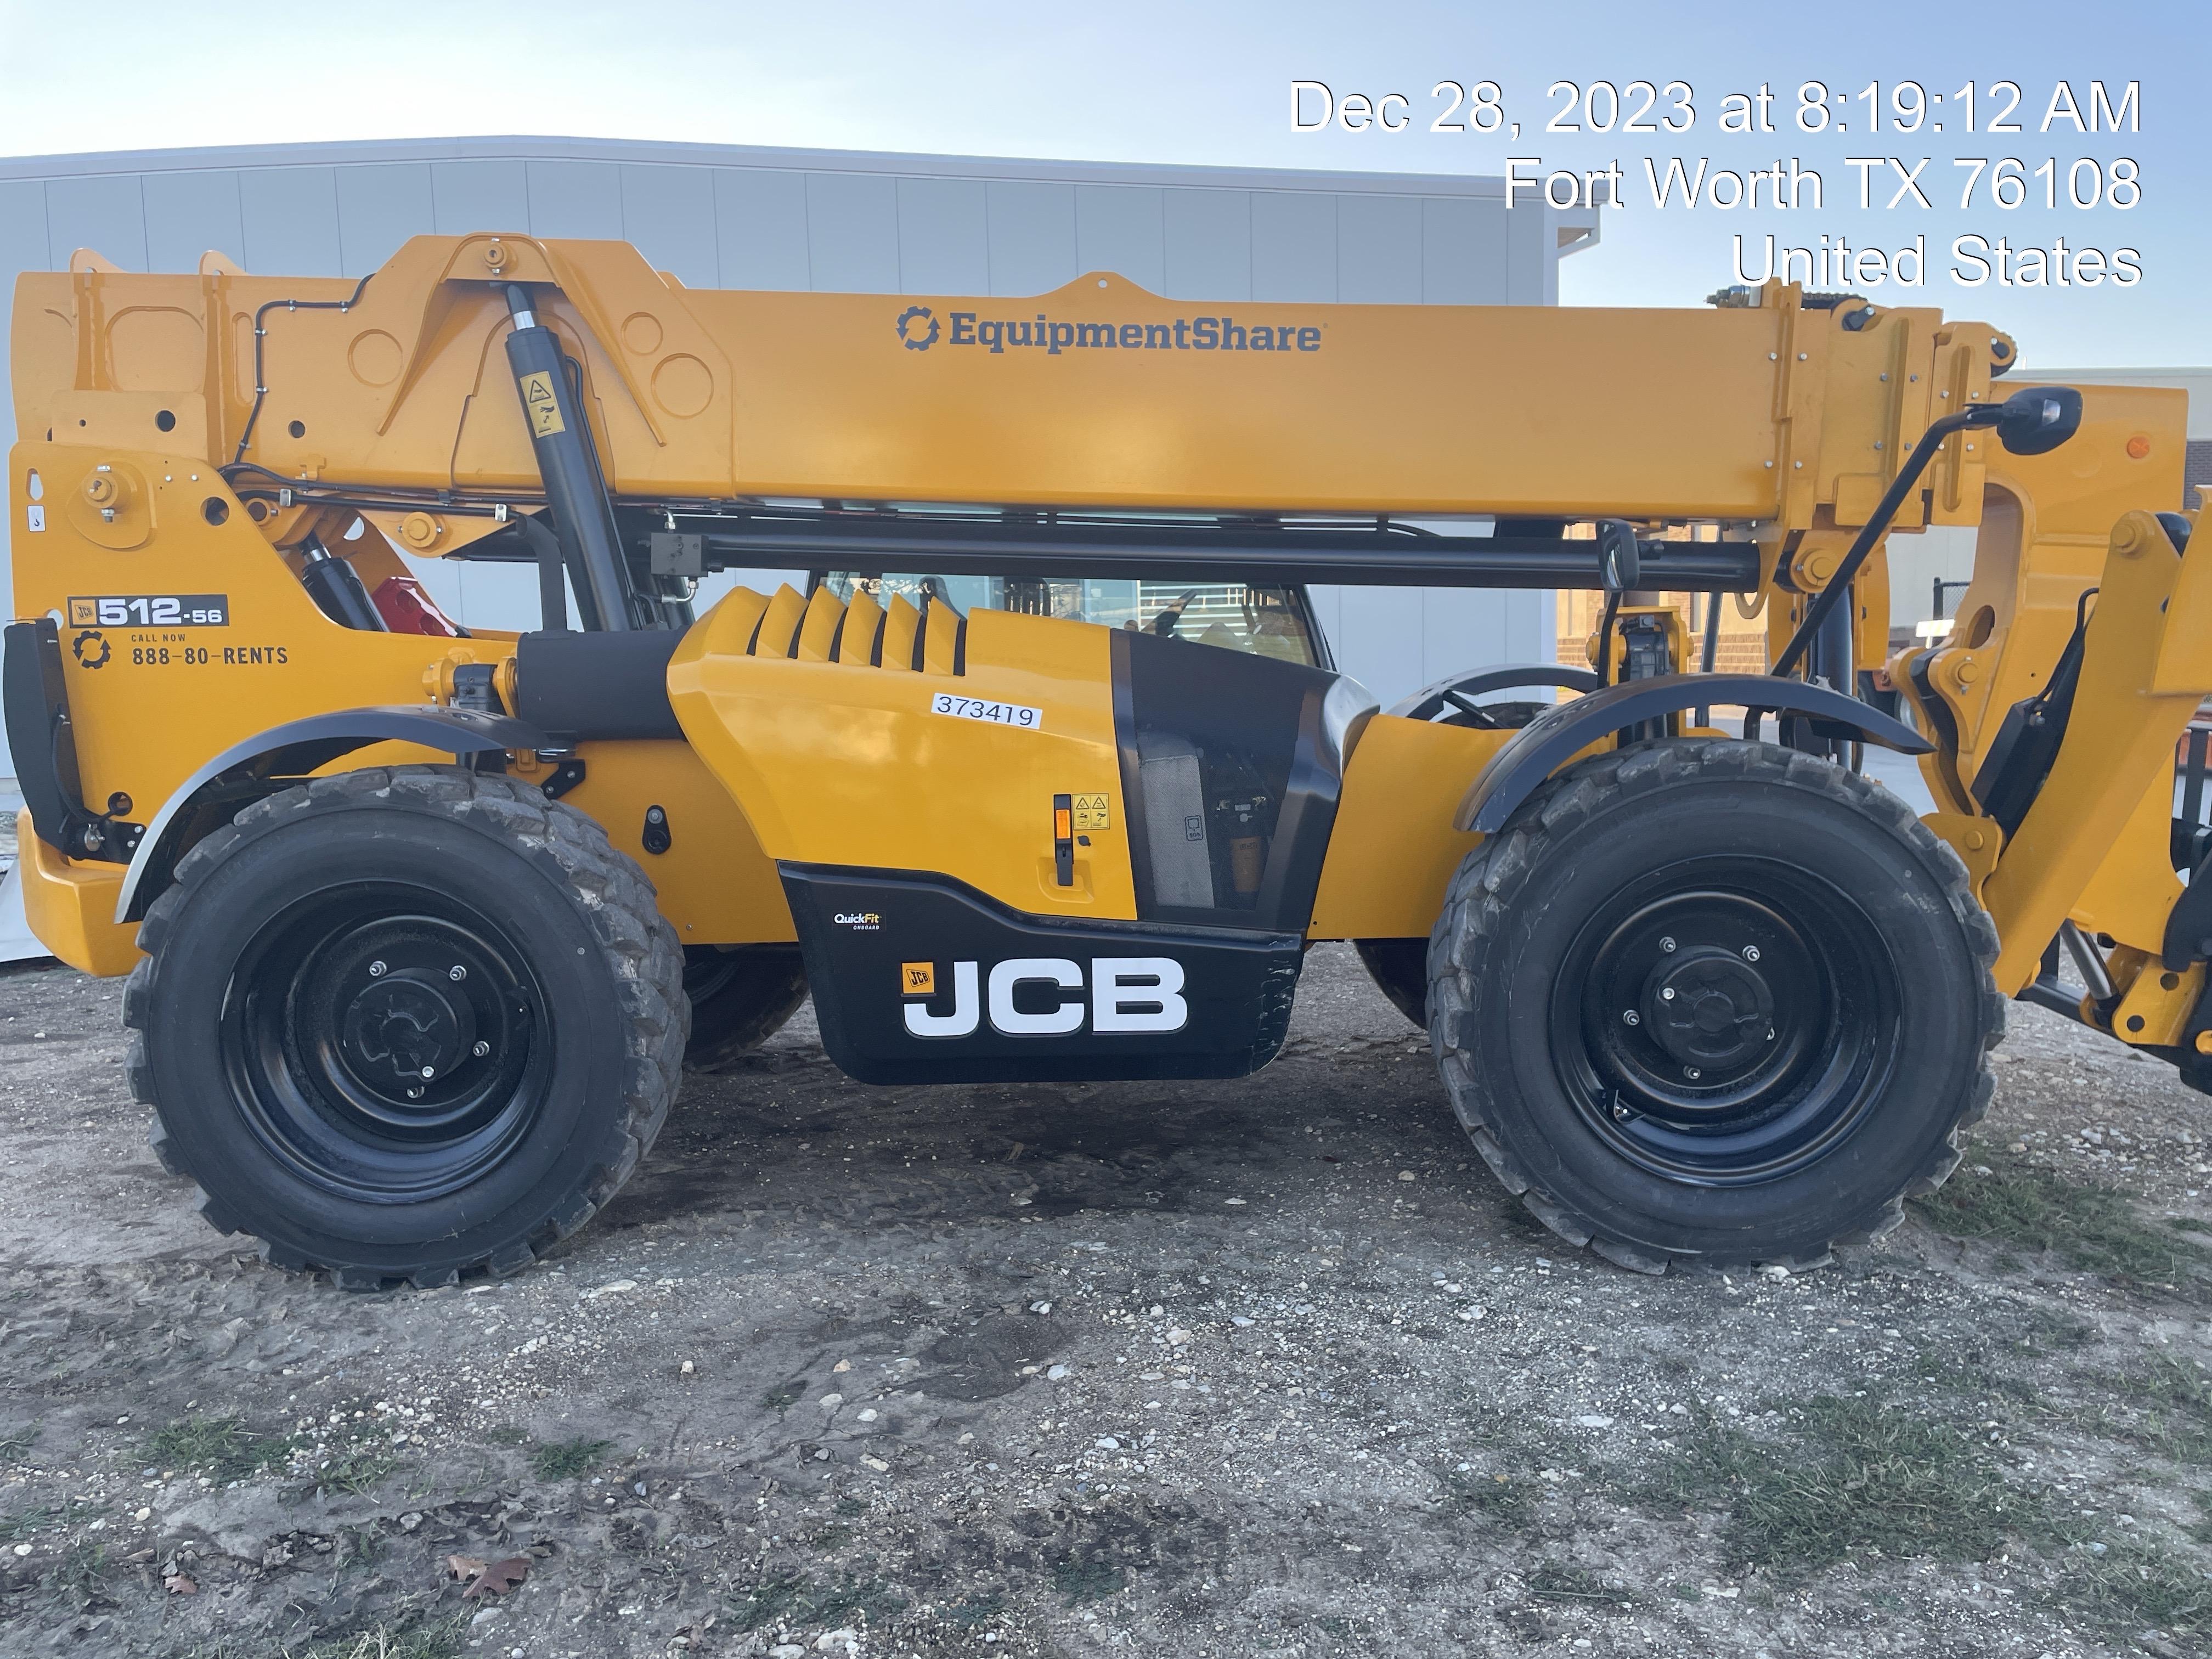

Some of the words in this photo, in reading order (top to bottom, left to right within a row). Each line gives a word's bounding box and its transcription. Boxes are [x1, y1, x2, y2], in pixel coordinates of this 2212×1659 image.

[949, 312, 1321, 354] EquipmentShare
[78, 606, 92, 618] JCB
[98, 597, 223, 625] 512-56
[131, 634, 157, 642] CALL
[162, 633, 187, 642] NOW
[132, 647, 289, 665] 888-80-RENTS
[936, 696, 1034, 726] 373419
[834, 913, 879, 924] QuickFit
[910, 970, 929, 985] JCB
[903, 957, 1188, 1037] JCB
